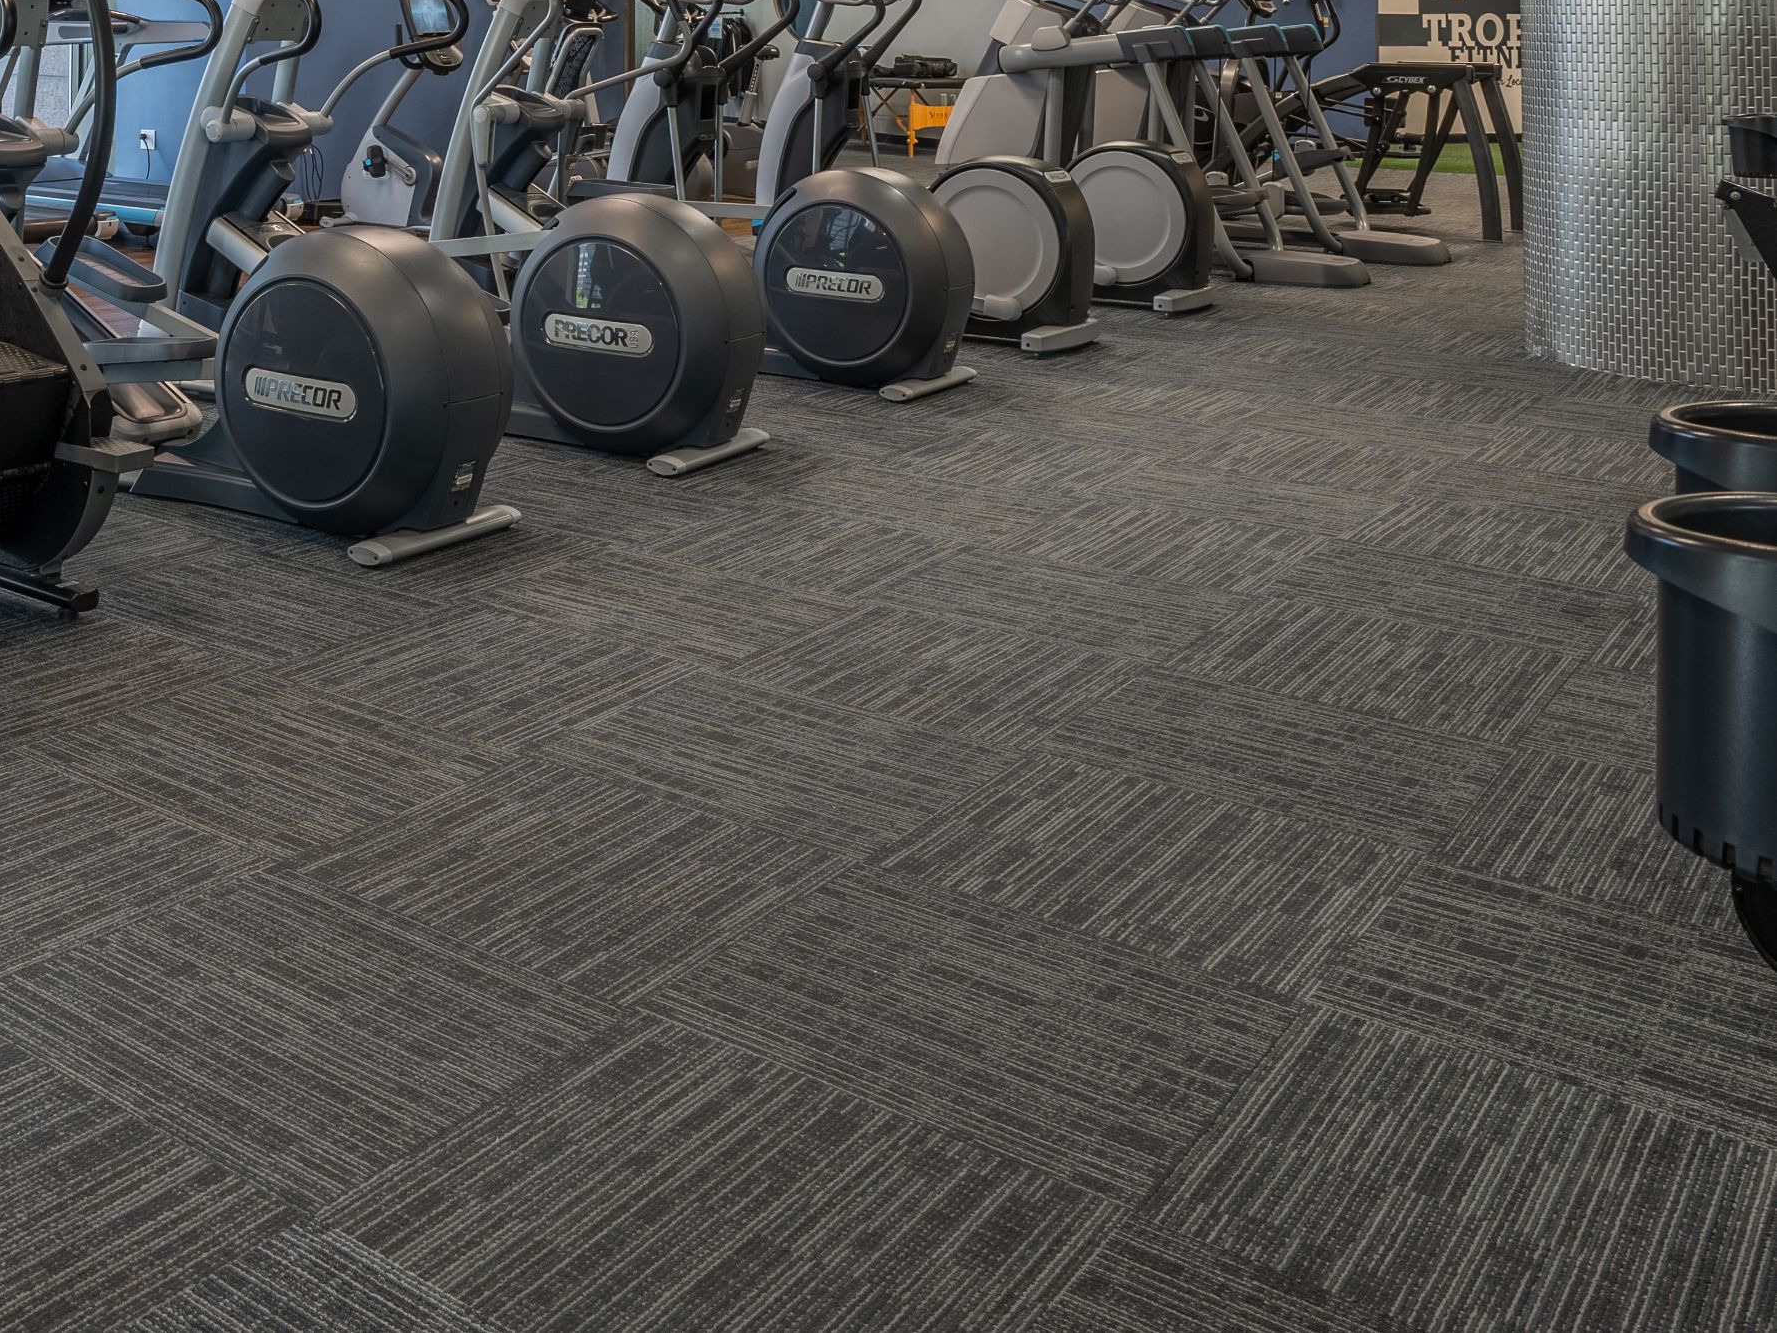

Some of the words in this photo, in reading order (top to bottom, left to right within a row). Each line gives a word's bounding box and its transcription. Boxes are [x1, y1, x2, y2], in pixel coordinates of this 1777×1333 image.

[1447, 45, 1522, 69] FITN
[795, 272, 872, 296] PRECOR
[554, 318, 629, 348] PRECOR
[253, 375, 342, 412] PRECOR
